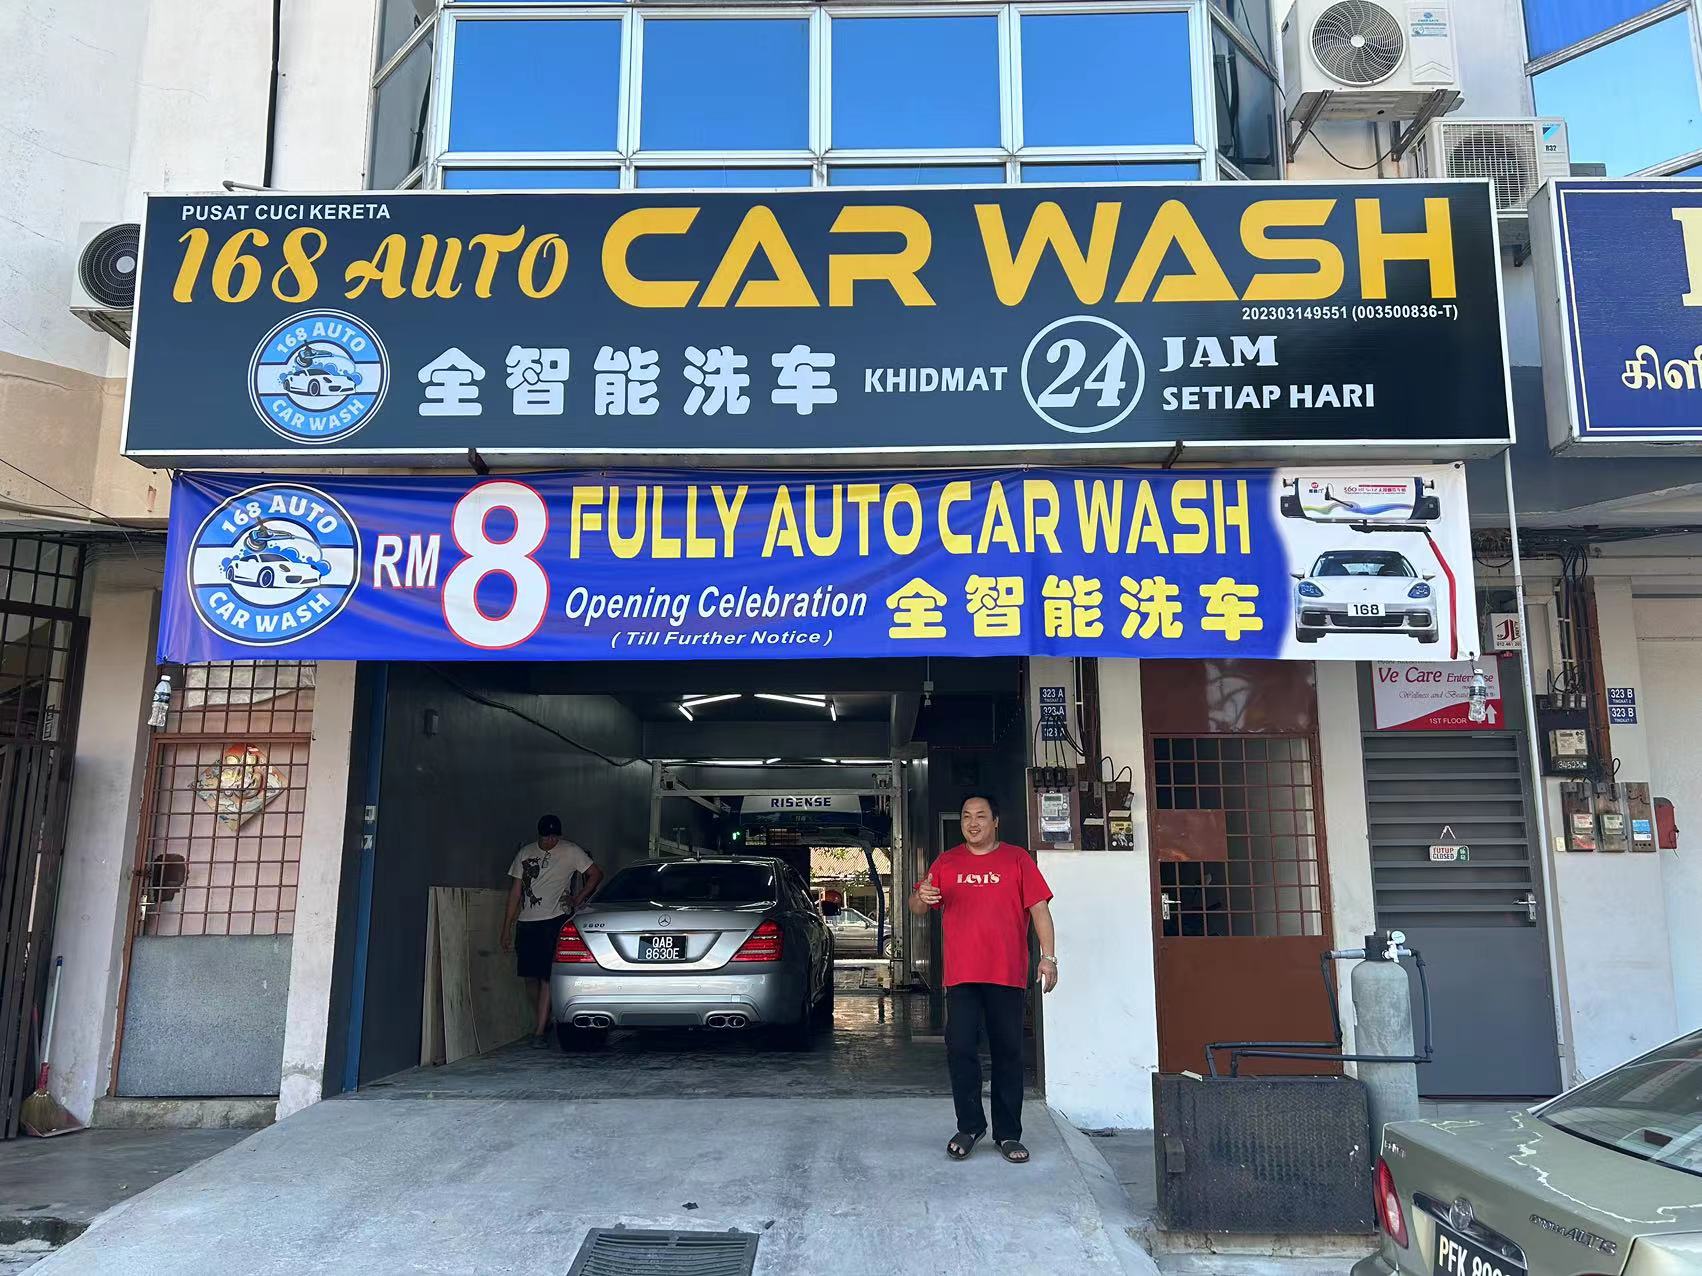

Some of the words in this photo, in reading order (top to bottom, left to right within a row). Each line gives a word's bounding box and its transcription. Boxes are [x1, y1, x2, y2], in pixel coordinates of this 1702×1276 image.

[182, 205, 249, 220] PUSAT
[255, 204, 304, 220] CUCI
[310, 203, 391, 219] KERETA
[173, 226, 328, 303] 168
[344, 224, 569, 299] AUTO
[602, 206, 936, 309] CAR
[974, 197, 1457, 306] WASH
[1242, 306, 1347, 320] 202303149551
[1352, 304, 1458, 321] (003500836-T)
[276, 327, 308, 354] 168
[312, 321, 367, 352] AUTO
[417, 345, 838, 416] 全智能洗车
[864, 367, 1008, 393] KHIDMAT
[1037, 337, 1128, 408] 24
[1159, 335, 1279, 373] JAM
[1162, 385, 1281, 411] SETIAP
[1289, 383, 1375, 408] HARI
[272, 399, 305, 428] CAR
[308, 398, 366, 431] WASH
[221, 501, 262, 534] 168
[268, 494, 338, 534] AUTO
[570, 485, 748, 559] FULLY
[761, 483, 923, 558] AUTO
[938, 480, 1062, 555] CAR
[1074, 479, 1251, 555] WASH
[373, 532, 441, 591] RM
[441, 479, 550, 650] 8
[208, 591, 250, 629] CAR
[255, 592, 332, 632] WASH
[565, 586, 691, 627] Opening
[705, 584, 868, 618] Celebration
[885, 574, 1264, 642] 全智能洗车
[1353, 604, 1380, 616] 168
[664, 631, 746, 646] Further
[1378, 667, 1399, 683] Ve
[1405, 666, 1443, 683] Care
[1042, 688, 1056, 698] 323
[1058, 688, 1064, 697] A
[1610, 688, 1625, 698] 323
[1627, 688, 1633, 698] B
[1611, 707, 1626, 718] 323
[1628, 707, 1634, 717] B
[771, 797, 832, 808] RISENSE
[652, 936, 673, 948] QAB
[1439, 1234, 1468, 1276] PFK
